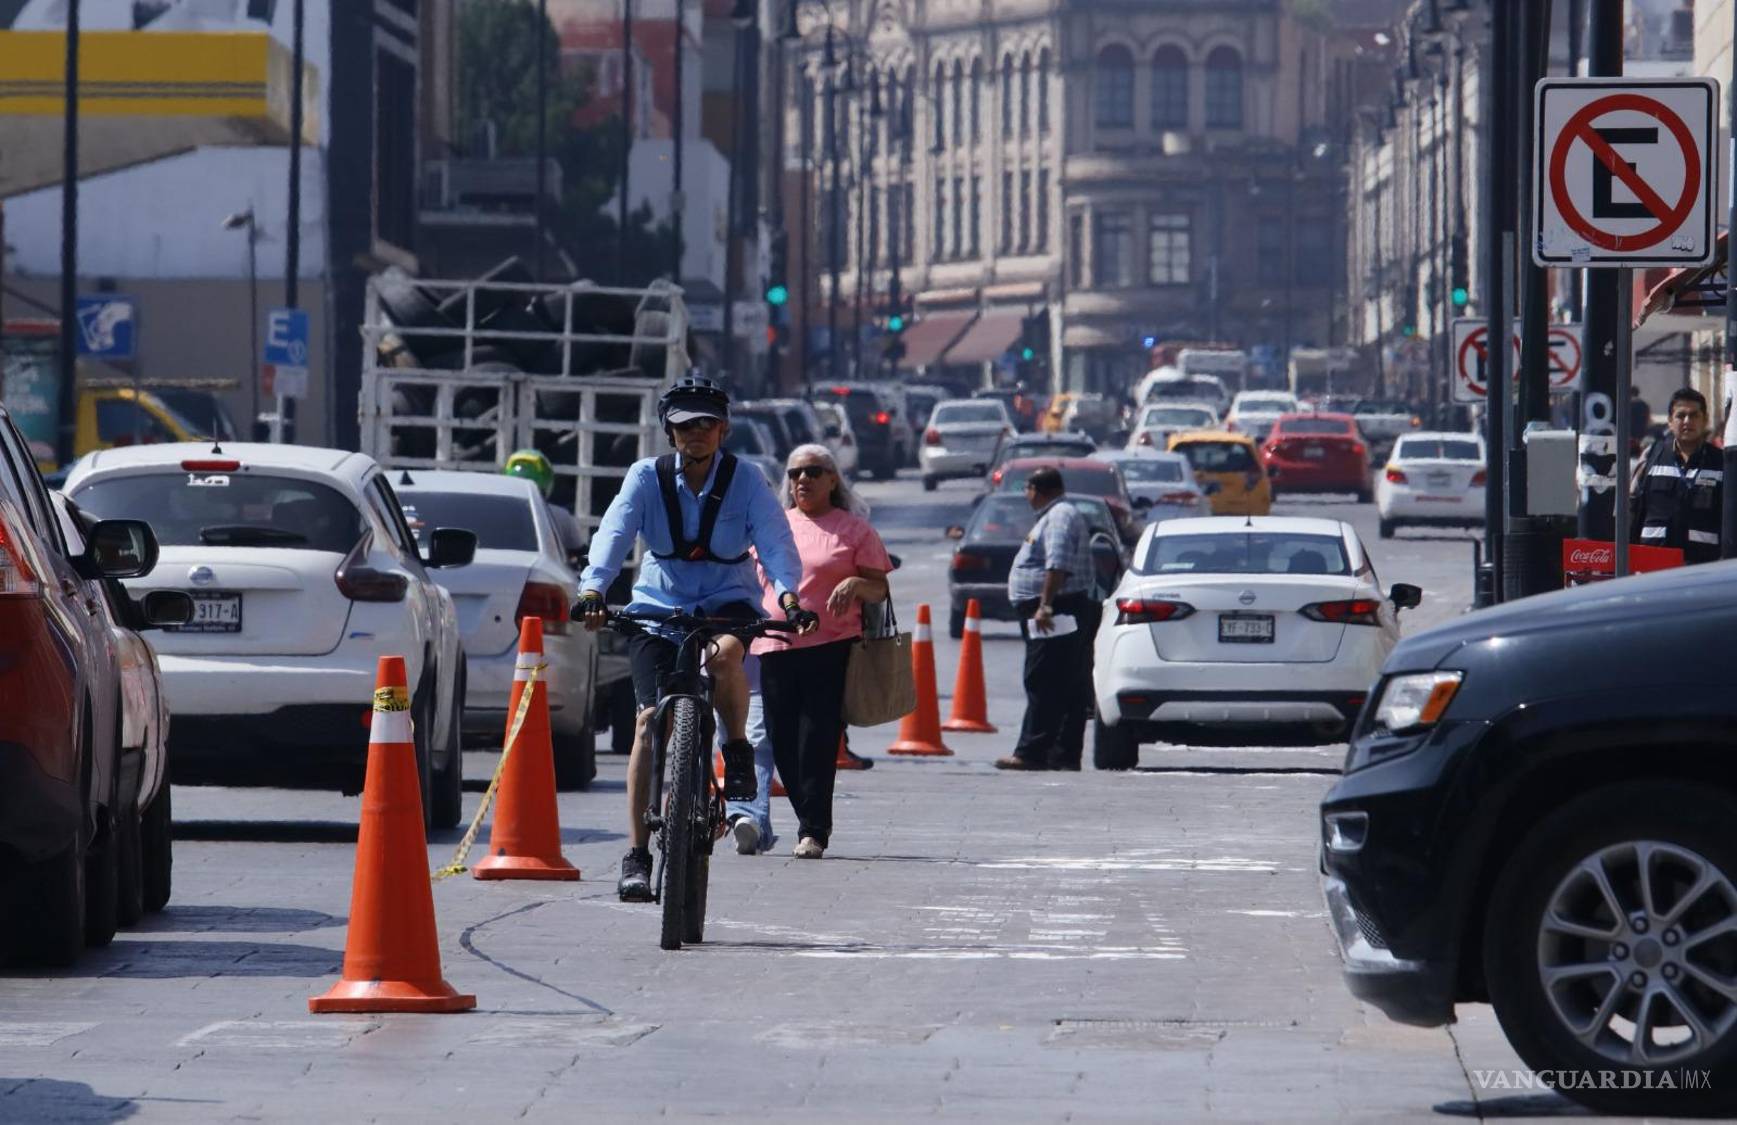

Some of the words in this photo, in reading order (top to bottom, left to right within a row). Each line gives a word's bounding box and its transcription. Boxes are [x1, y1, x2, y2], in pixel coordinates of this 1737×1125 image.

[1593, 127, 1658, 218] E
[269, 311, 289, 347] E
[197, 603, 238, 619] 317-A
